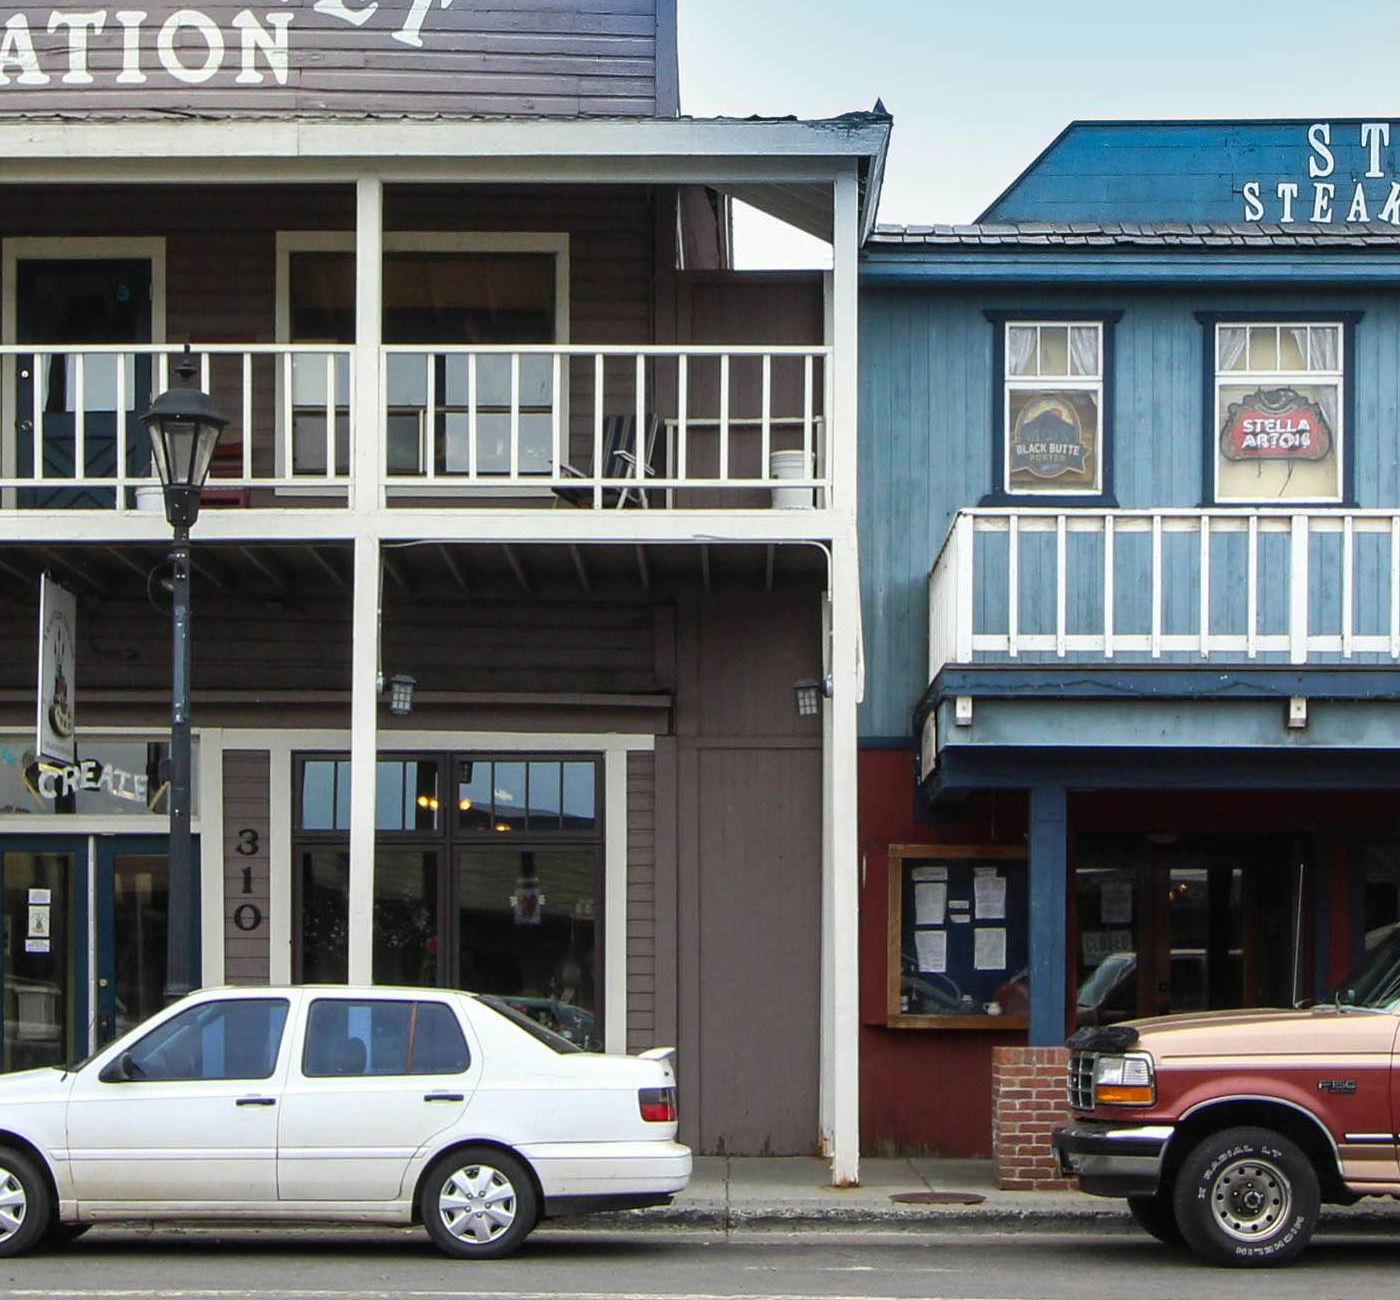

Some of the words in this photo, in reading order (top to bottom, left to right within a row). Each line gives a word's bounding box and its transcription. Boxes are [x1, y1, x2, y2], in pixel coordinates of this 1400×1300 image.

[0, 8, 295, 84] ATION
[1308, 123, 1390, 178] ST
[1242, 419, 1311, 432] STELLA
[1016, 443, 1047, 455] BLACK
[1049, 443, 1081, 456] BUTTE
[1241, 432, 1311, 449] ARTOIS
[37, 760, 149, 802] CREATE
